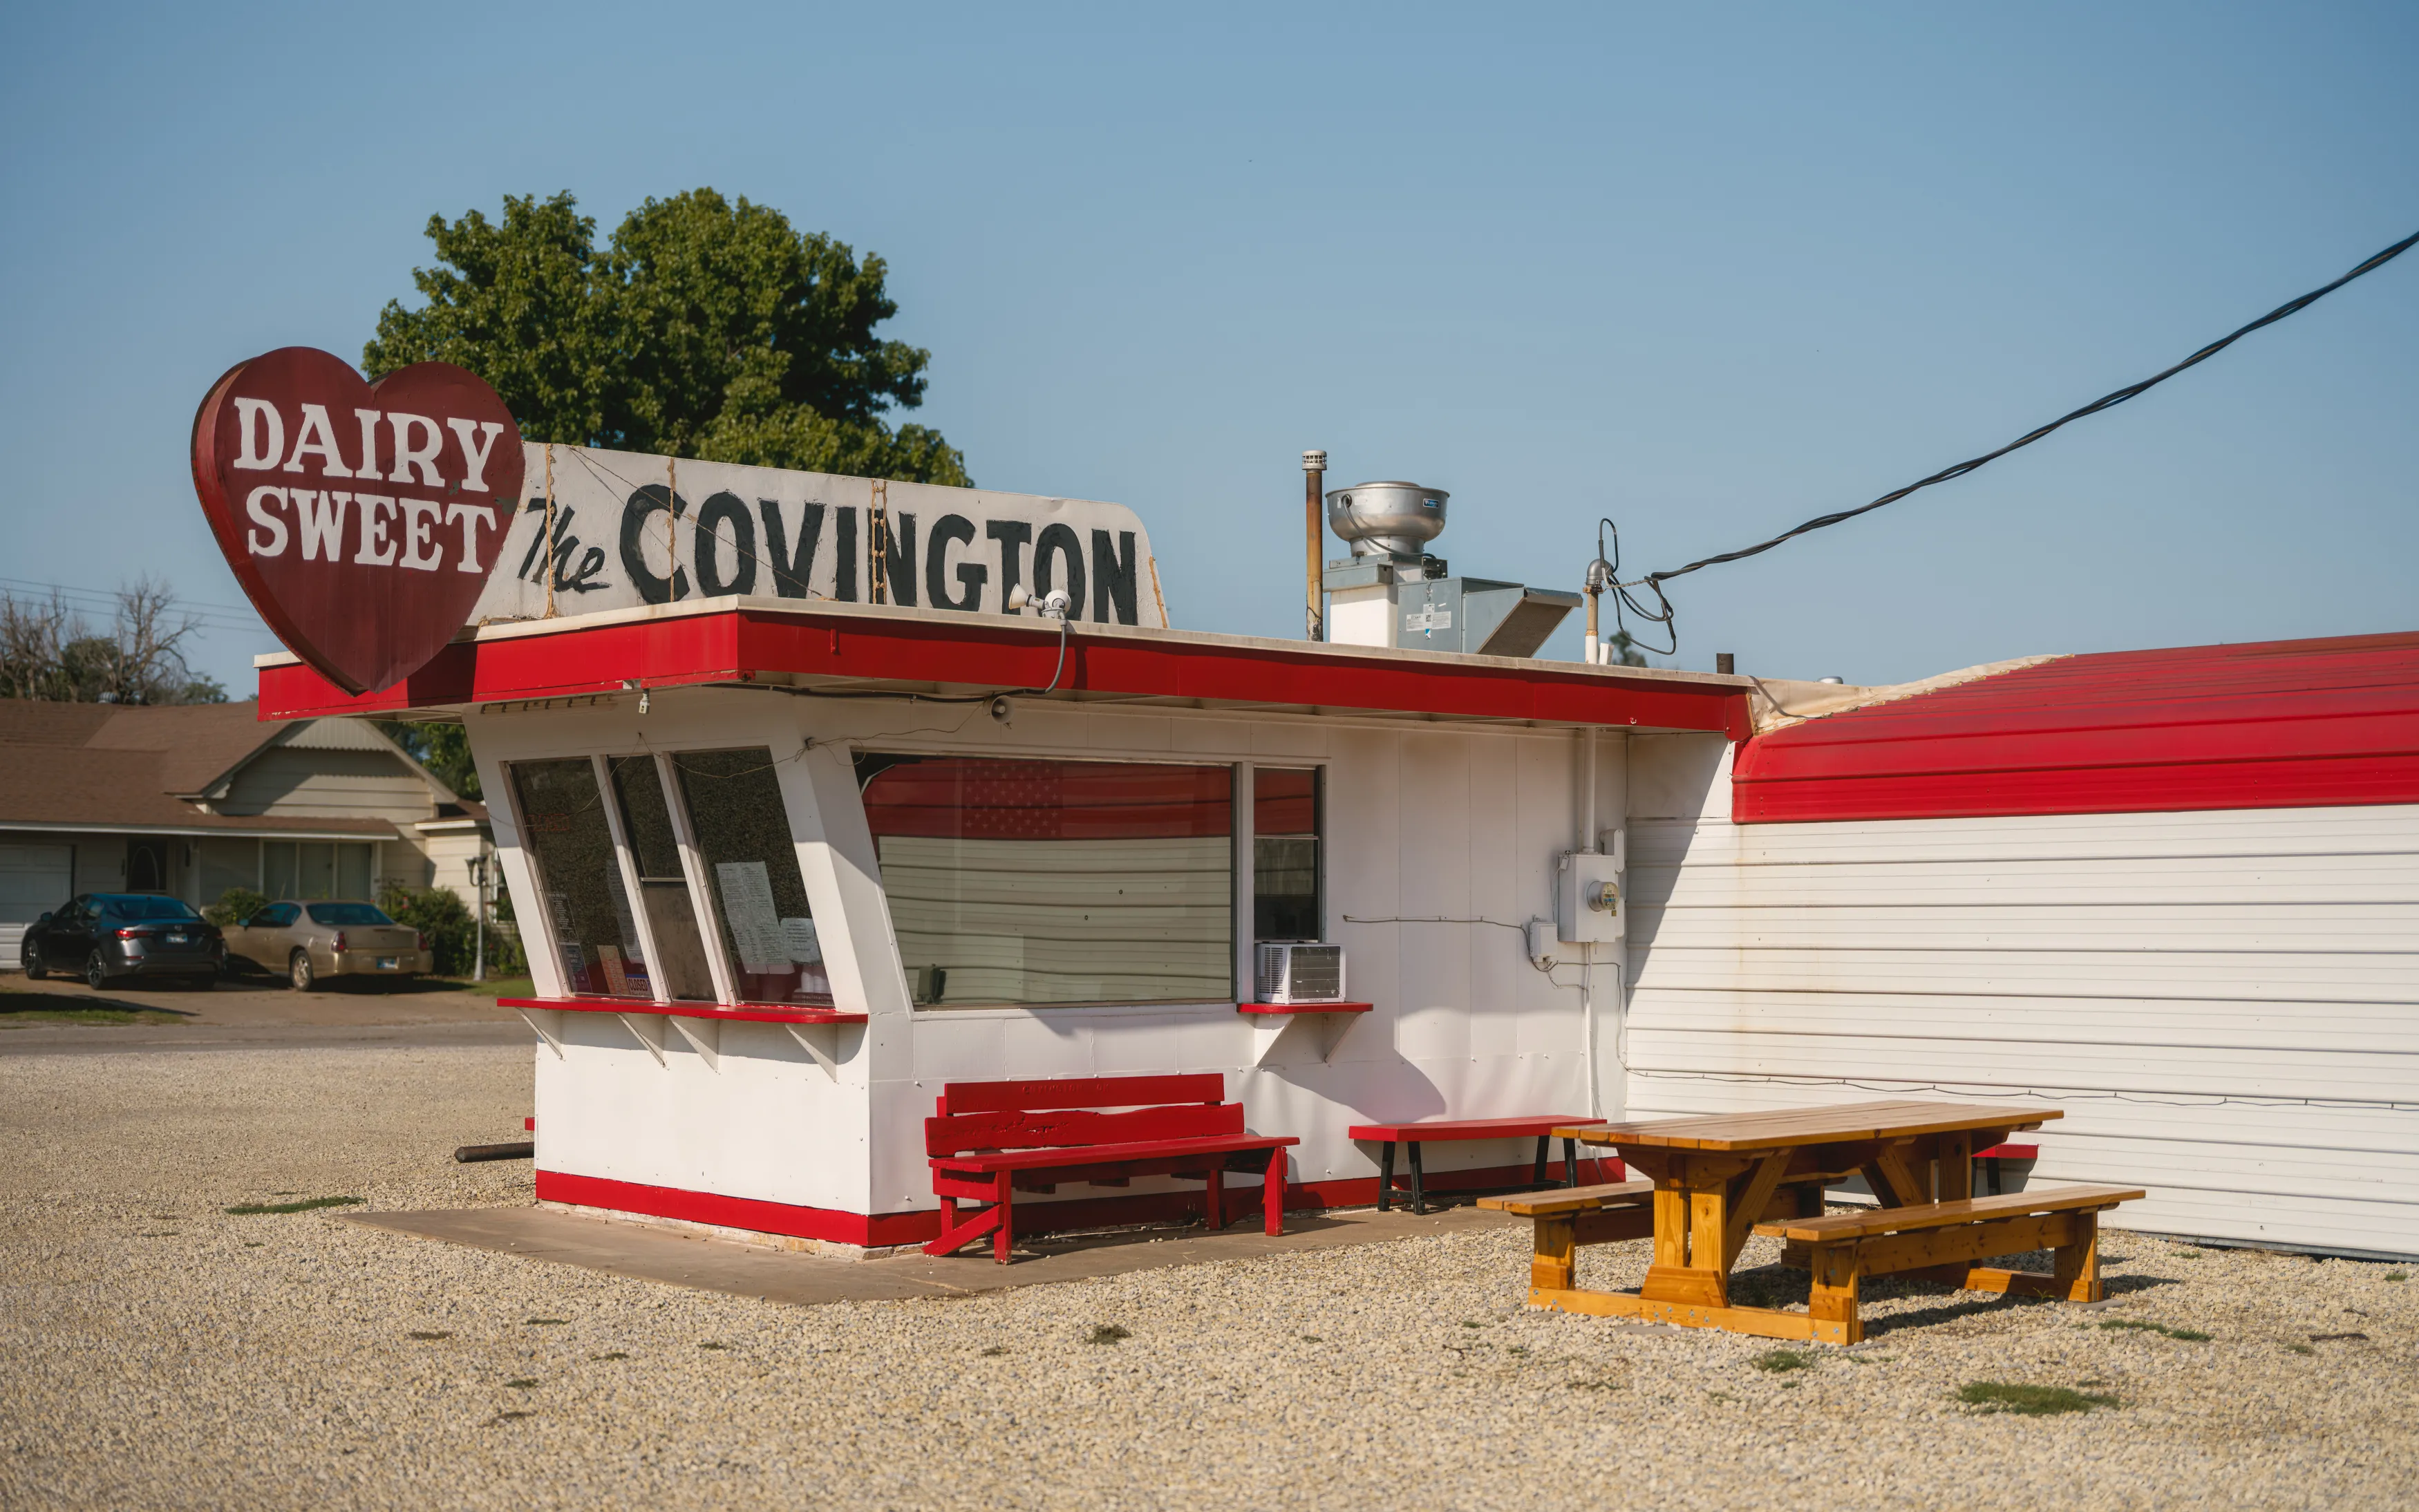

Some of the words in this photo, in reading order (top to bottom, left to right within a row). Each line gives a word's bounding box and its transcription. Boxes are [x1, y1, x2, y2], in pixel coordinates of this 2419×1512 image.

[233, 397, 504, 492] DAIRY
[246, 485, 498, 574] SWEET
[517, 497, 613, 594] The
[619, 483, 1139, 626] COVINGTON
[628, 978, 648, 992] CLOSED
